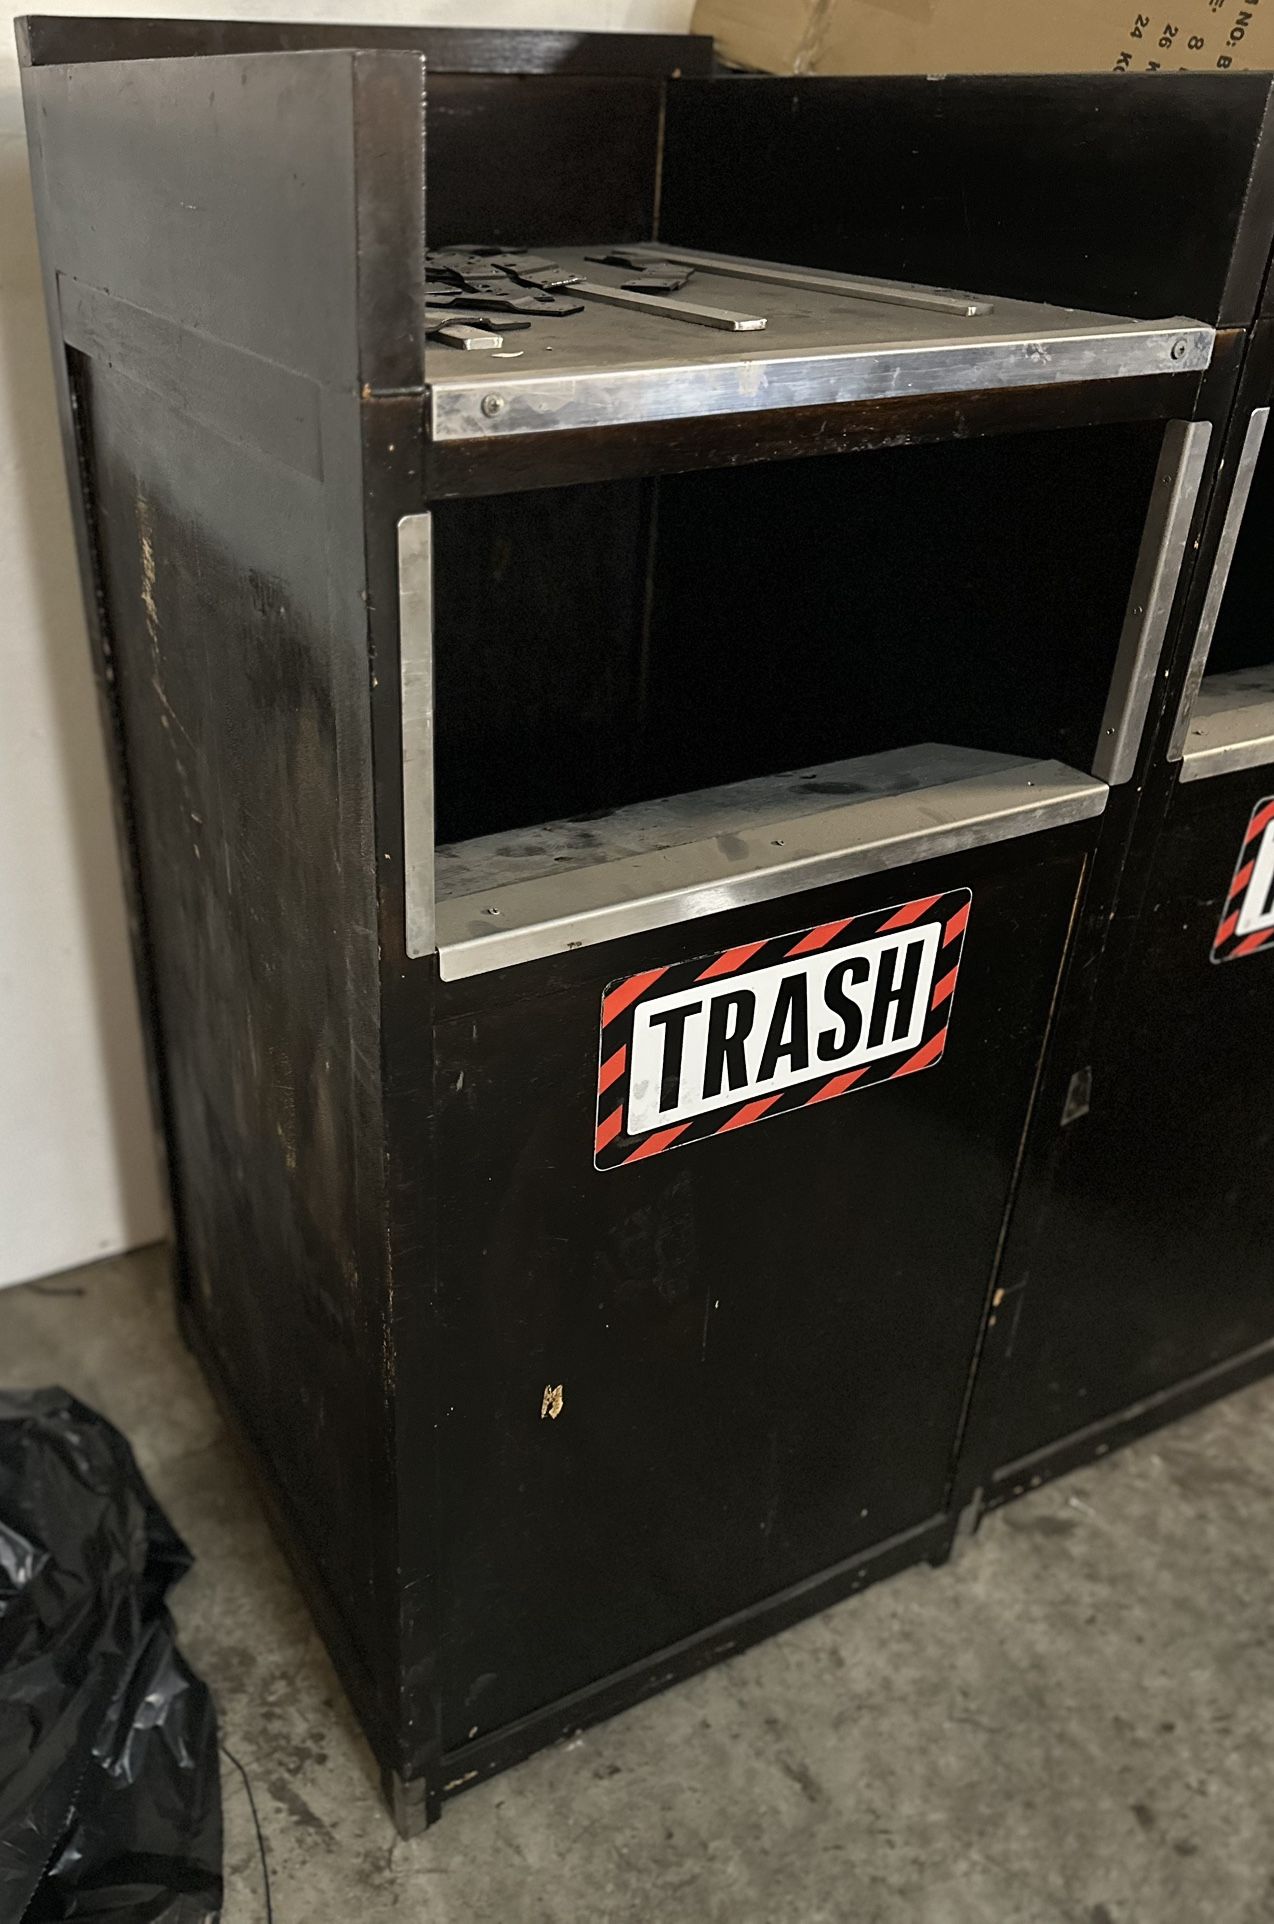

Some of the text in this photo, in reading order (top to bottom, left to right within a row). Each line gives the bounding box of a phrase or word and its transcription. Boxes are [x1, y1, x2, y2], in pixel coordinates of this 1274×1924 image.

[1130, 14, 1150, 40] 24
[1158, 23, 1179, 50] 26
[1226, 11, 1253, 48] NO:
[1187, 35, 1204, 51] 8
[649, 938, 927, 1114] TRASH
